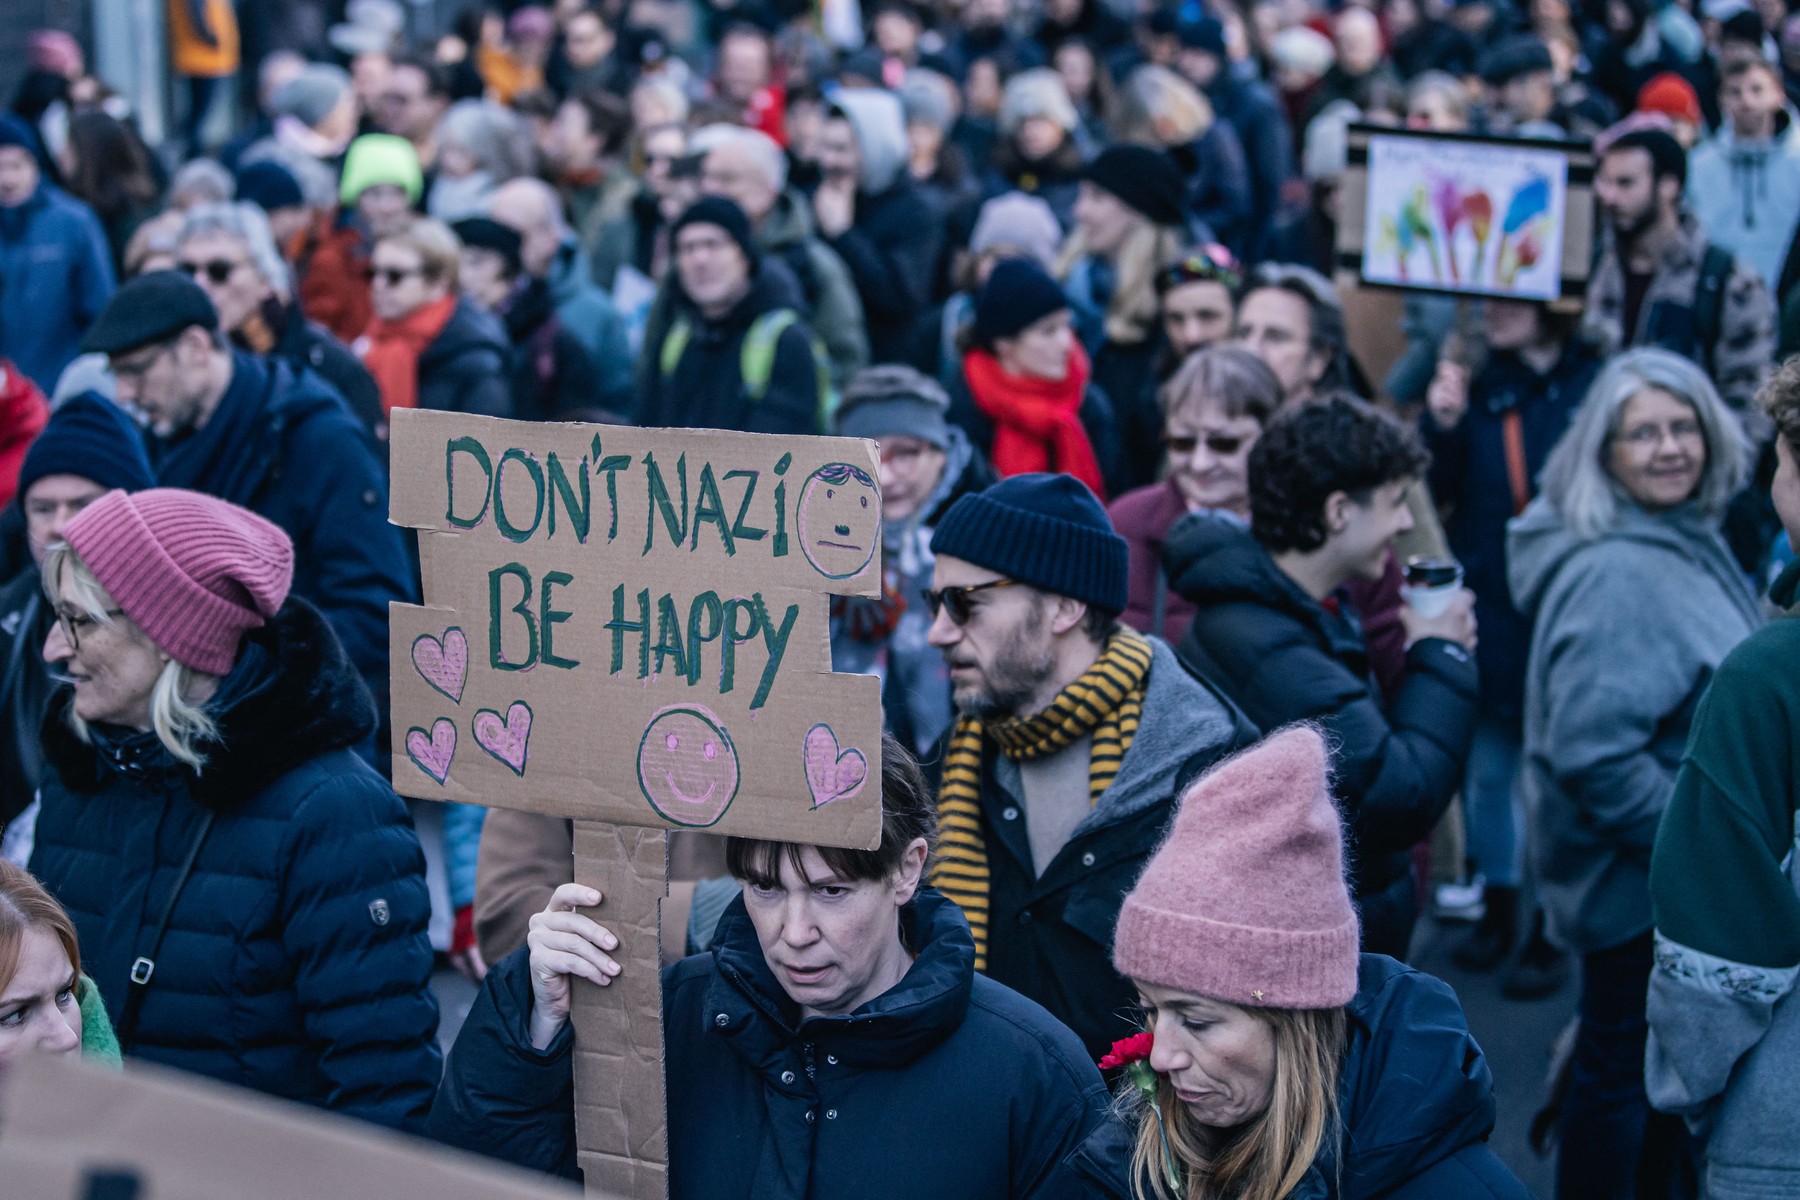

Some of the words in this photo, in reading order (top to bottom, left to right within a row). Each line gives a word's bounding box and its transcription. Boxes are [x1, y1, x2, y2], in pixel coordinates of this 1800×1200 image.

[446, 432, 632, 544] DON'T
[488, 561, 581, 672] BE
[603, 583, 799, 719] HAPPY
